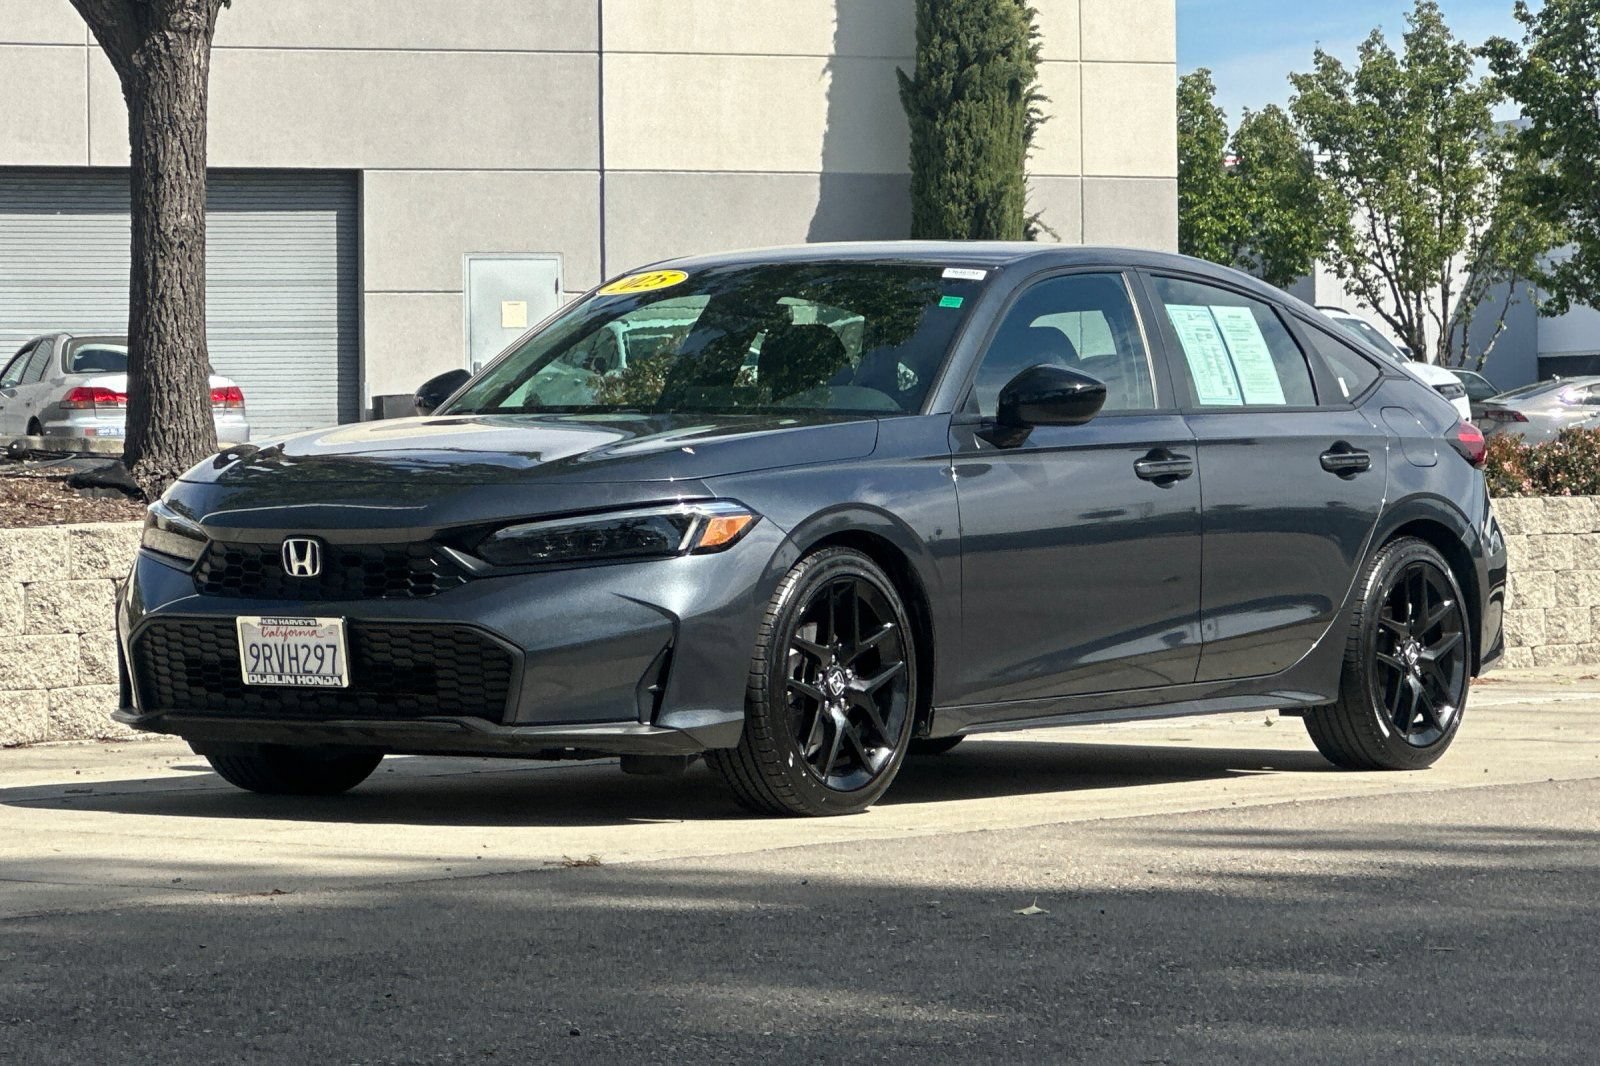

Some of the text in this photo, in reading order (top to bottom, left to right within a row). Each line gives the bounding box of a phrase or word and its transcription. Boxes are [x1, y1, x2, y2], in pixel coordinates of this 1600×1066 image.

[262, 618, 316, 627] KEN HARVEY'S
[261, 626, 325, 642] California
[249, 643, 338, 675] 9RVH297
[248, 674, 342, 686] DUBLIN HONDA
